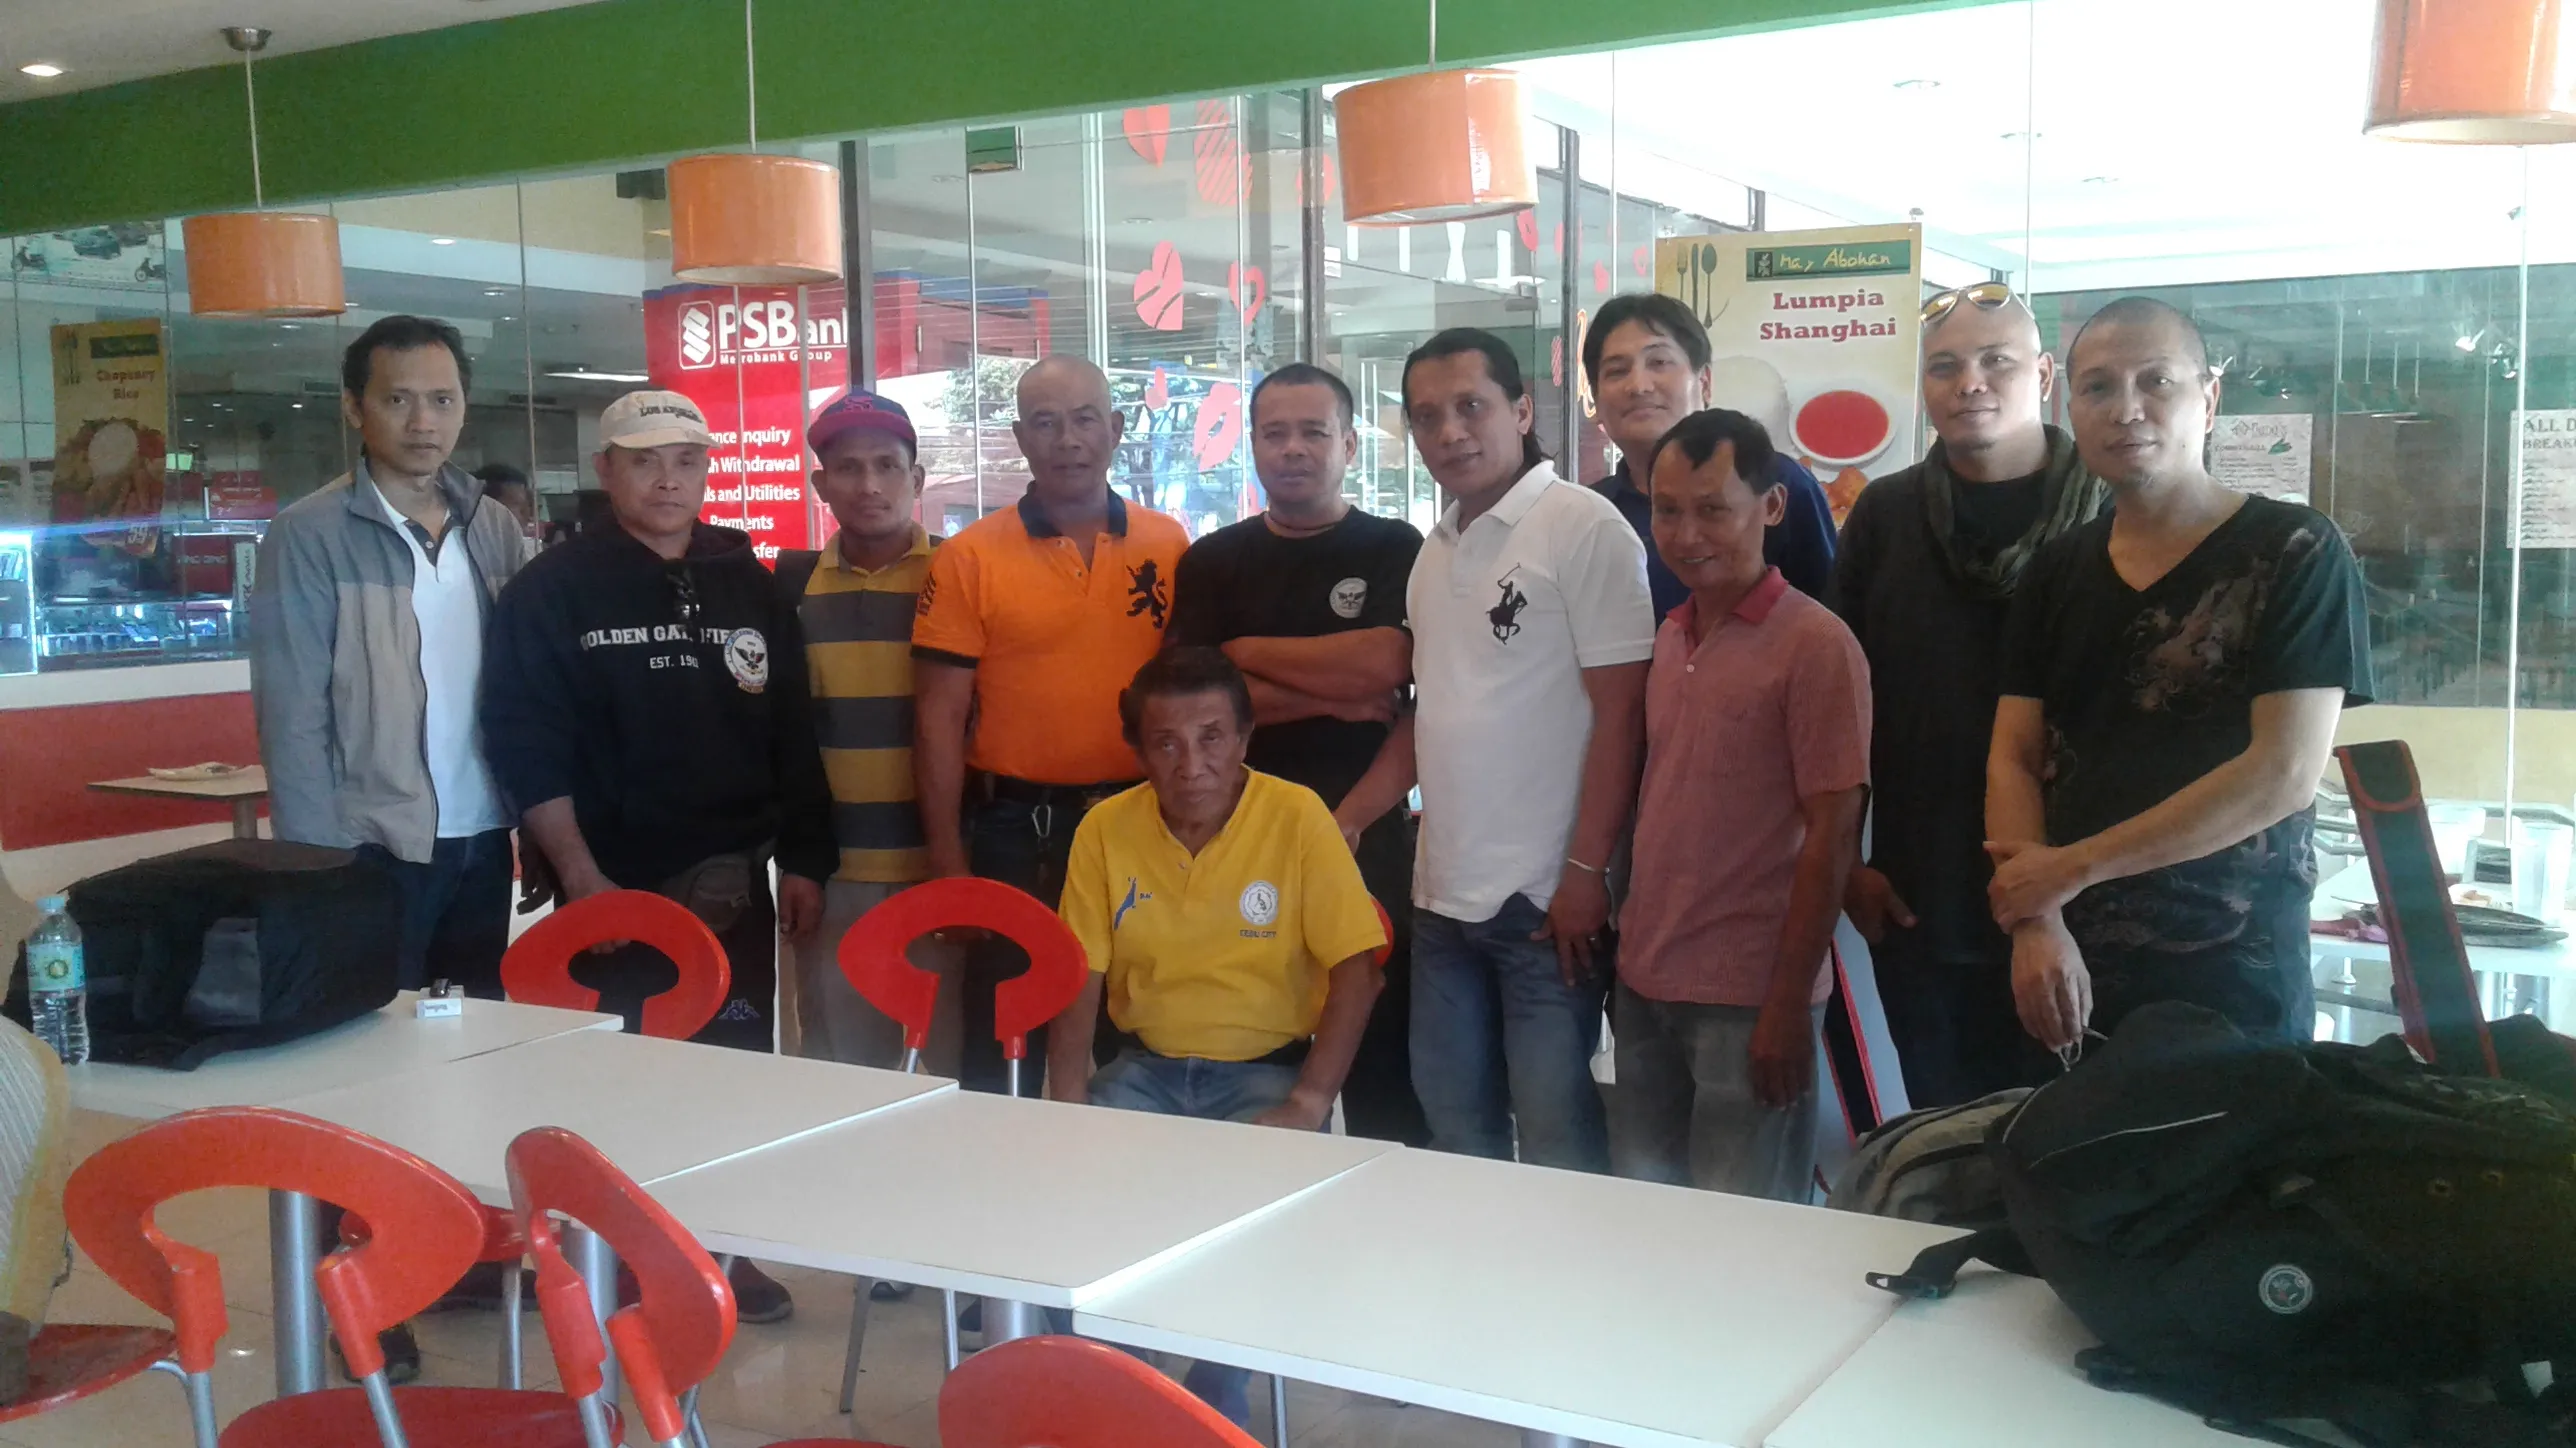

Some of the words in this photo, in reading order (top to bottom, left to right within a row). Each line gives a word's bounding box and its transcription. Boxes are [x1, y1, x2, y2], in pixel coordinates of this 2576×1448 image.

[1772, 288, 1886, 313] Lumpia
[1760, 317, 1897, 343] Shanghai
[720, 350, 786, 365] Merobank
[789, 350, 833, 364] Goup
[2523, 419, 2561, 432] ALL
[743, 426, 792, 447] nquiry
[718, 485, 742, 501] and
[745, 484, 801, 501] Utilities
[650, 656, 675, 669] EST.
